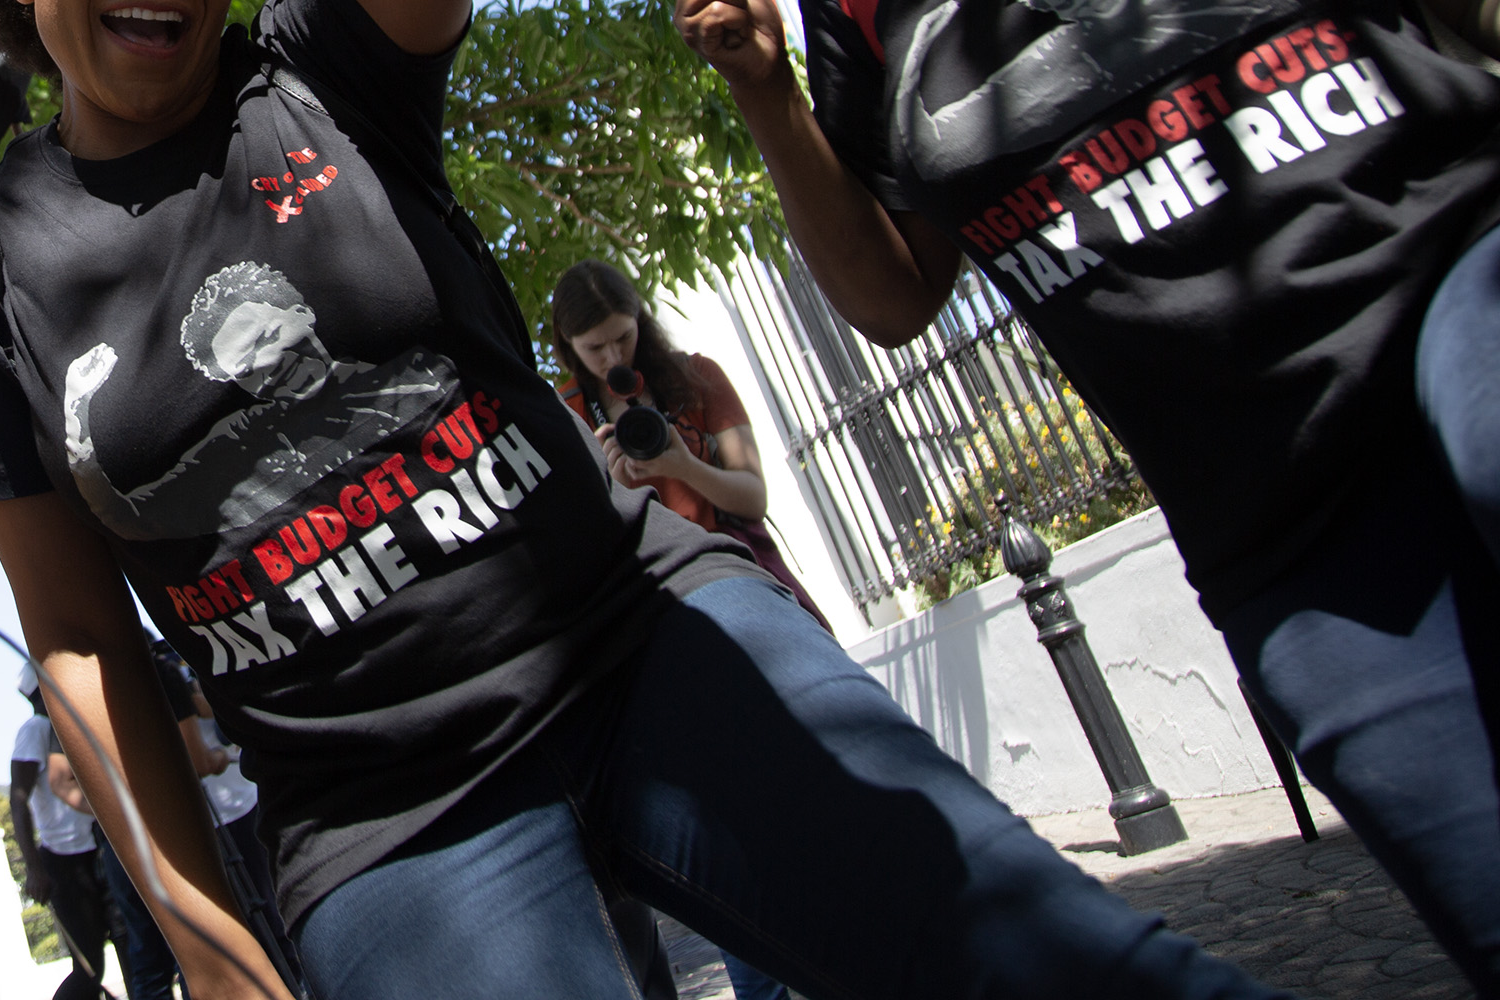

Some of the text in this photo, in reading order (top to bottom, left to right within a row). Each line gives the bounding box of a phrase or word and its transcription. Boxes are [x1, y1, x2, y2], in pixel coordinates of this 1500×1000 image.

[251, 176, 281, 192] CRY
[959, 173, 1065, 255] FIGHT
[1059, 74, 1233, 194] BUDGET
[993, 57, 1406, 304] TAX THE RICH
[590, 400, 608, 426] ONY
[165, 559, 255, 625] FIGHT
[252, 452, 419, 586] BUDGET
[188, 423, 552, 677] TAX THE RICH
